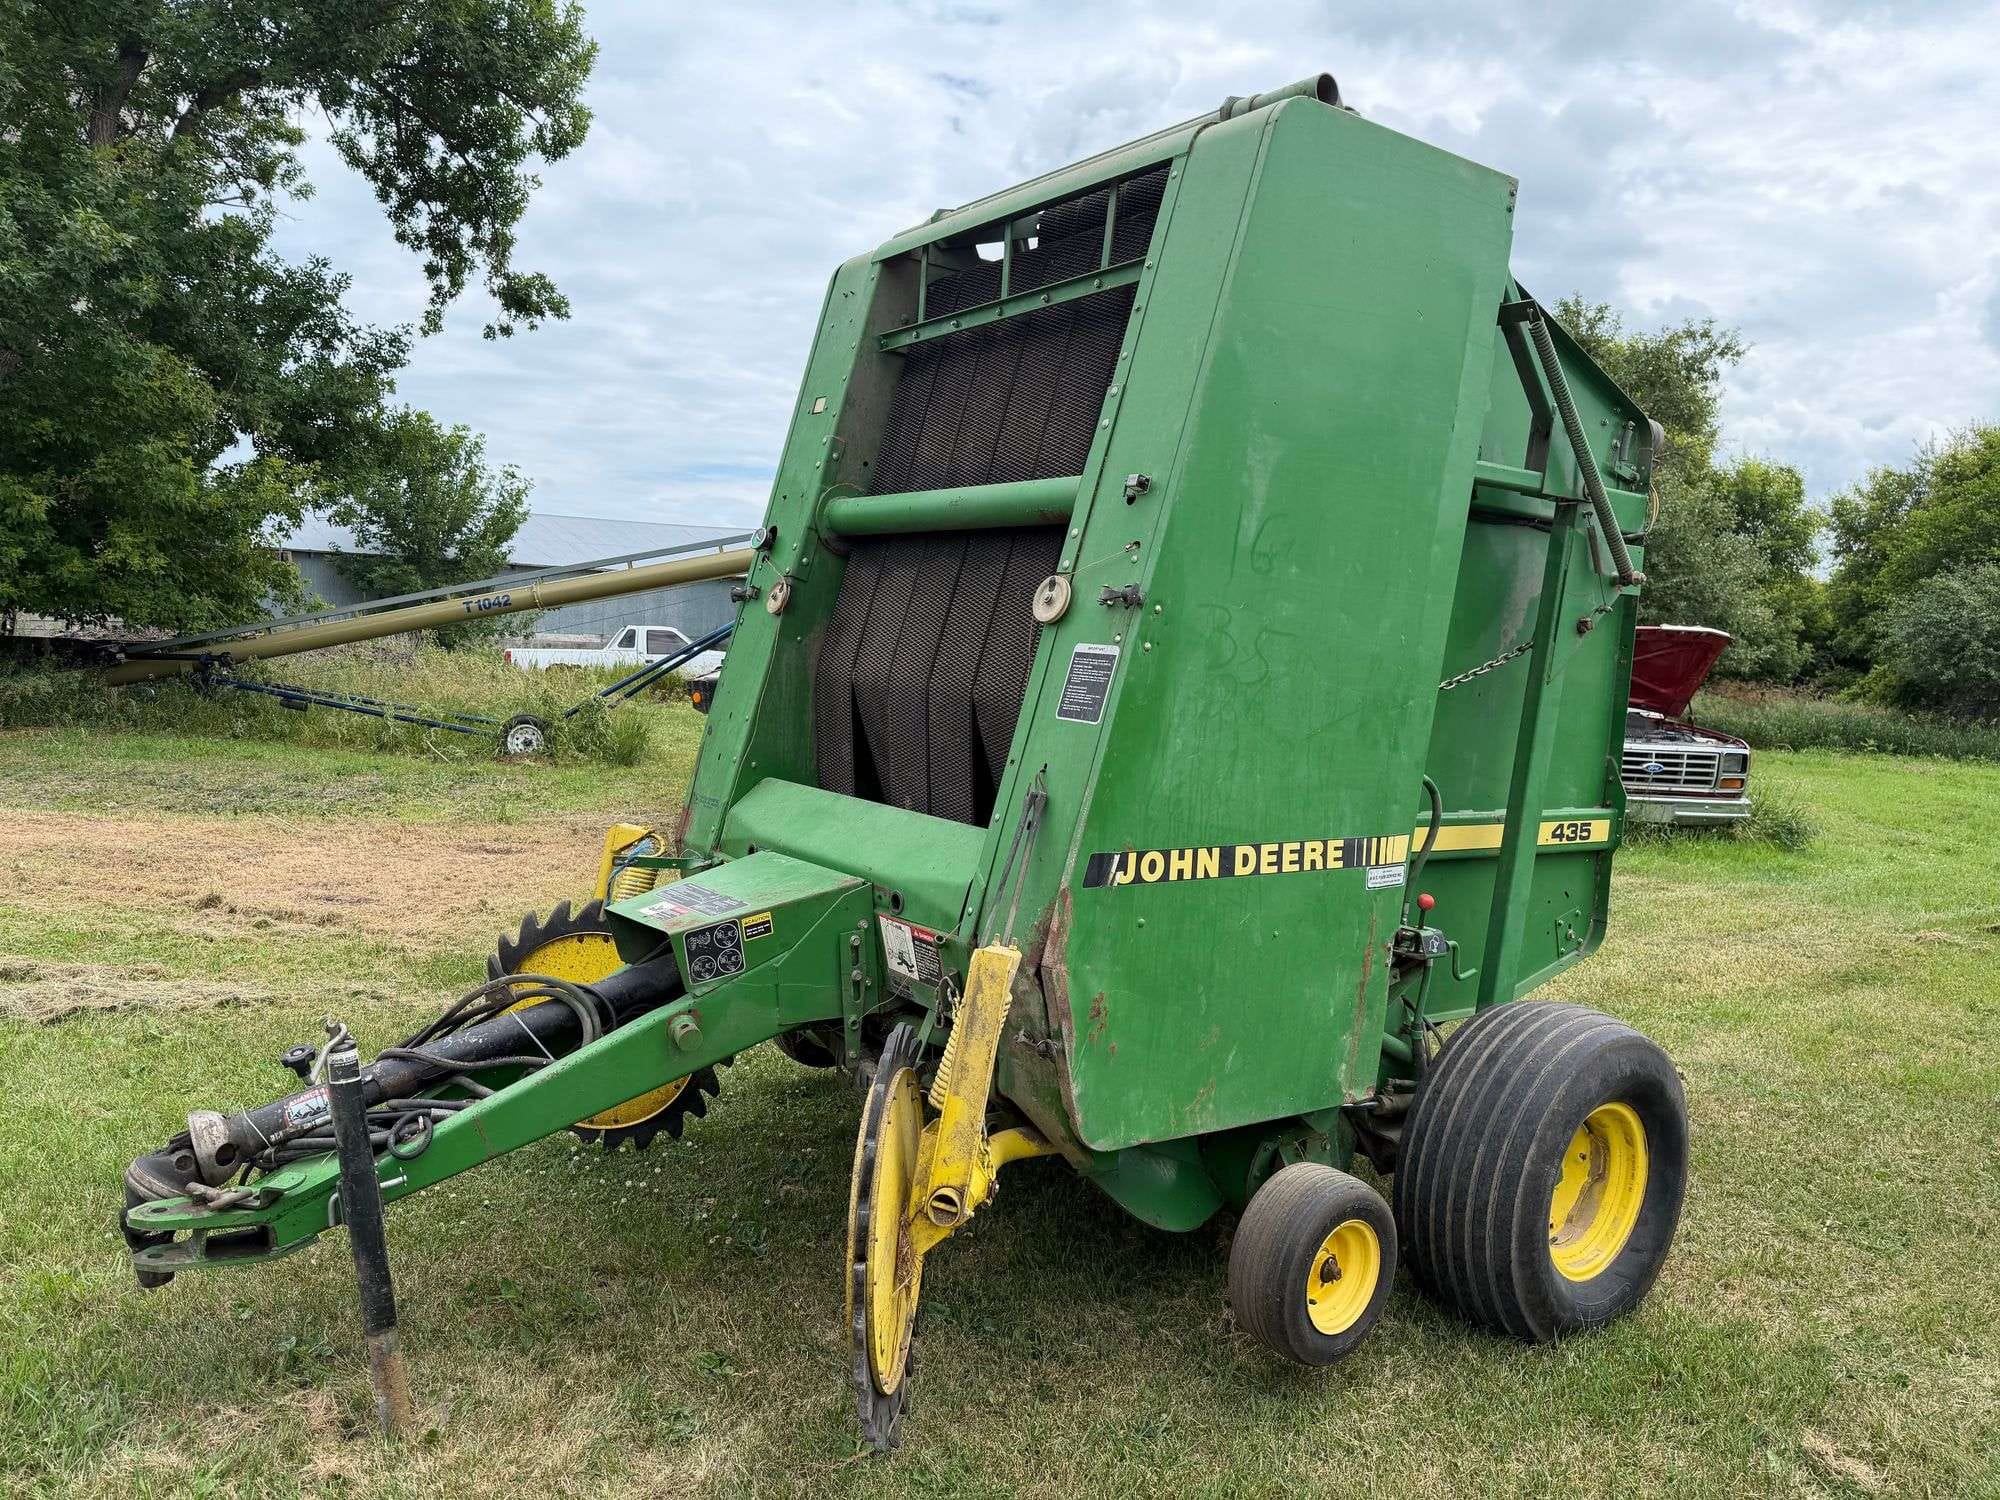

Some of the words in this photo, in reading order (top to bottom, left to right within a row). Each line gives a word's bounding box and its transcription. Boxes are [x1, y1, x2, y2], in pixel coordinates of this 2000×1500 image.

[463, 595, 512, 613] T1042
[1551, 822, 1592, 842] 435
[1116, 847, 1221, 885] JOHN
[1233, 840, 1345, 876] DEERE
